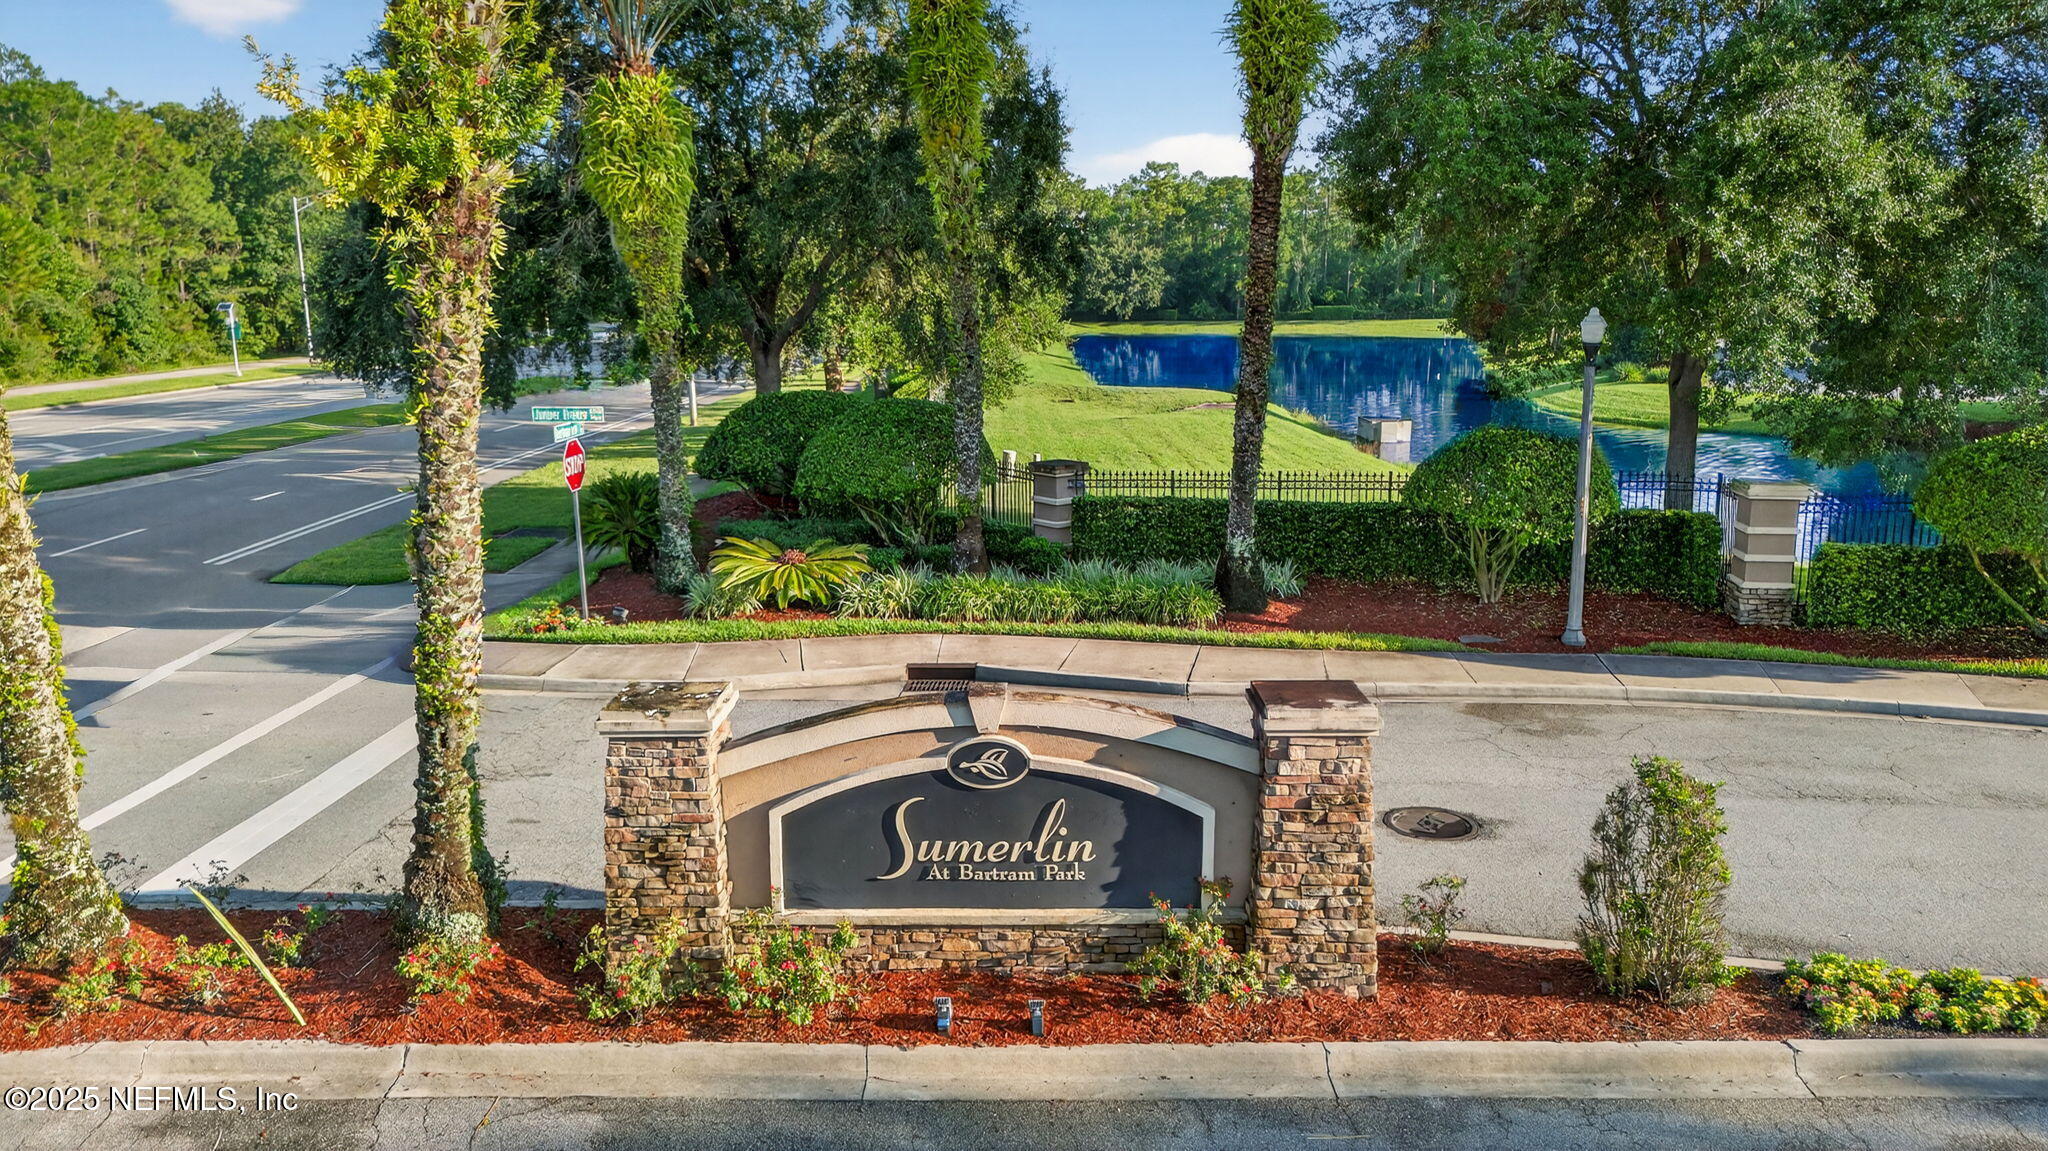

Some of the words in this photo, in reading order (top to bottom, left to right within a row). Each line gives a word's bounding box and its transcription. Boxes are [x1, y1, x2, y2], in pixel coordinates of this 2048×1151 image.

[565, 453, 583, 477] STOP
[876, 797, 1096, 880] Sumerlin
[926, 864, 951, 881] At
[958, 864, 1036, 881] Bartram
[1043, 861, 1087, 881] Park
